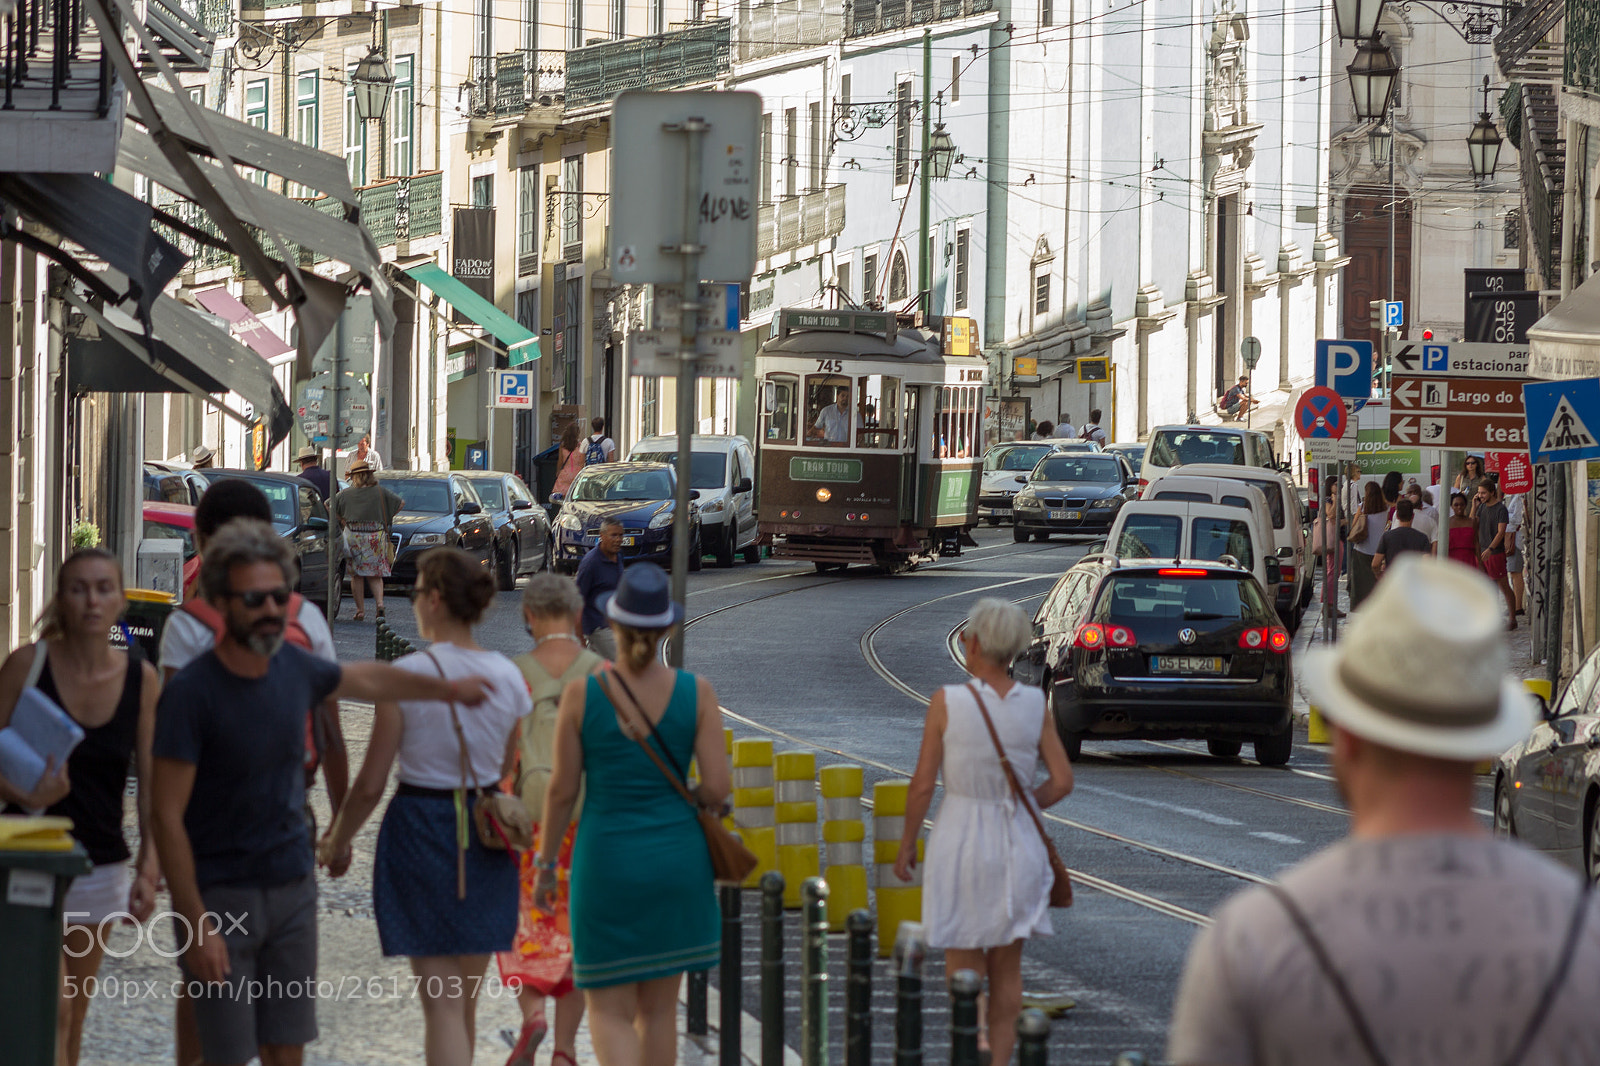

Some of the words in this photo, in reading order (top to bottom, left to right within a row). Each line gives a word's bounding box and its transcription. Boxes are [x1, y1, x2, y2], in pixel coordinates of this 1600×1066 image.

[701, 193, 749, 223] ALONE
[455, 259, 482, 268] FADO
[454, 267, 492, 275] CHIADO
[1388, 304, 1399, 324] P
[799, 316, 818, 326] TRAM
[821, 317, 840, 327] TOUR
[1495, 301, 1506, 342] STO
[1507, 301, 1515, 344] CONC
[1427, 347, 1444, 369] P
[1509, 351, 1529, 360] par
[816, 360, 842, 373] 745
[1327, 345, 1360, 390] P
[1453, 359, 1528, 372] estacionar
[503, 375, 518, 395] P
[1449, 389, 1490, 405] Largo
[1495, 391, 1513, 403] do
[803, 461, 824, 472] TRAM
[827, 462, 849, 473] TOUR
[1370, 459, 1390, 467] your
[1392, 458, 1413, 466] way
[1505, 480, 1529, 489] payshop
[1160, 657, 1214, 670] 05-EL-20
